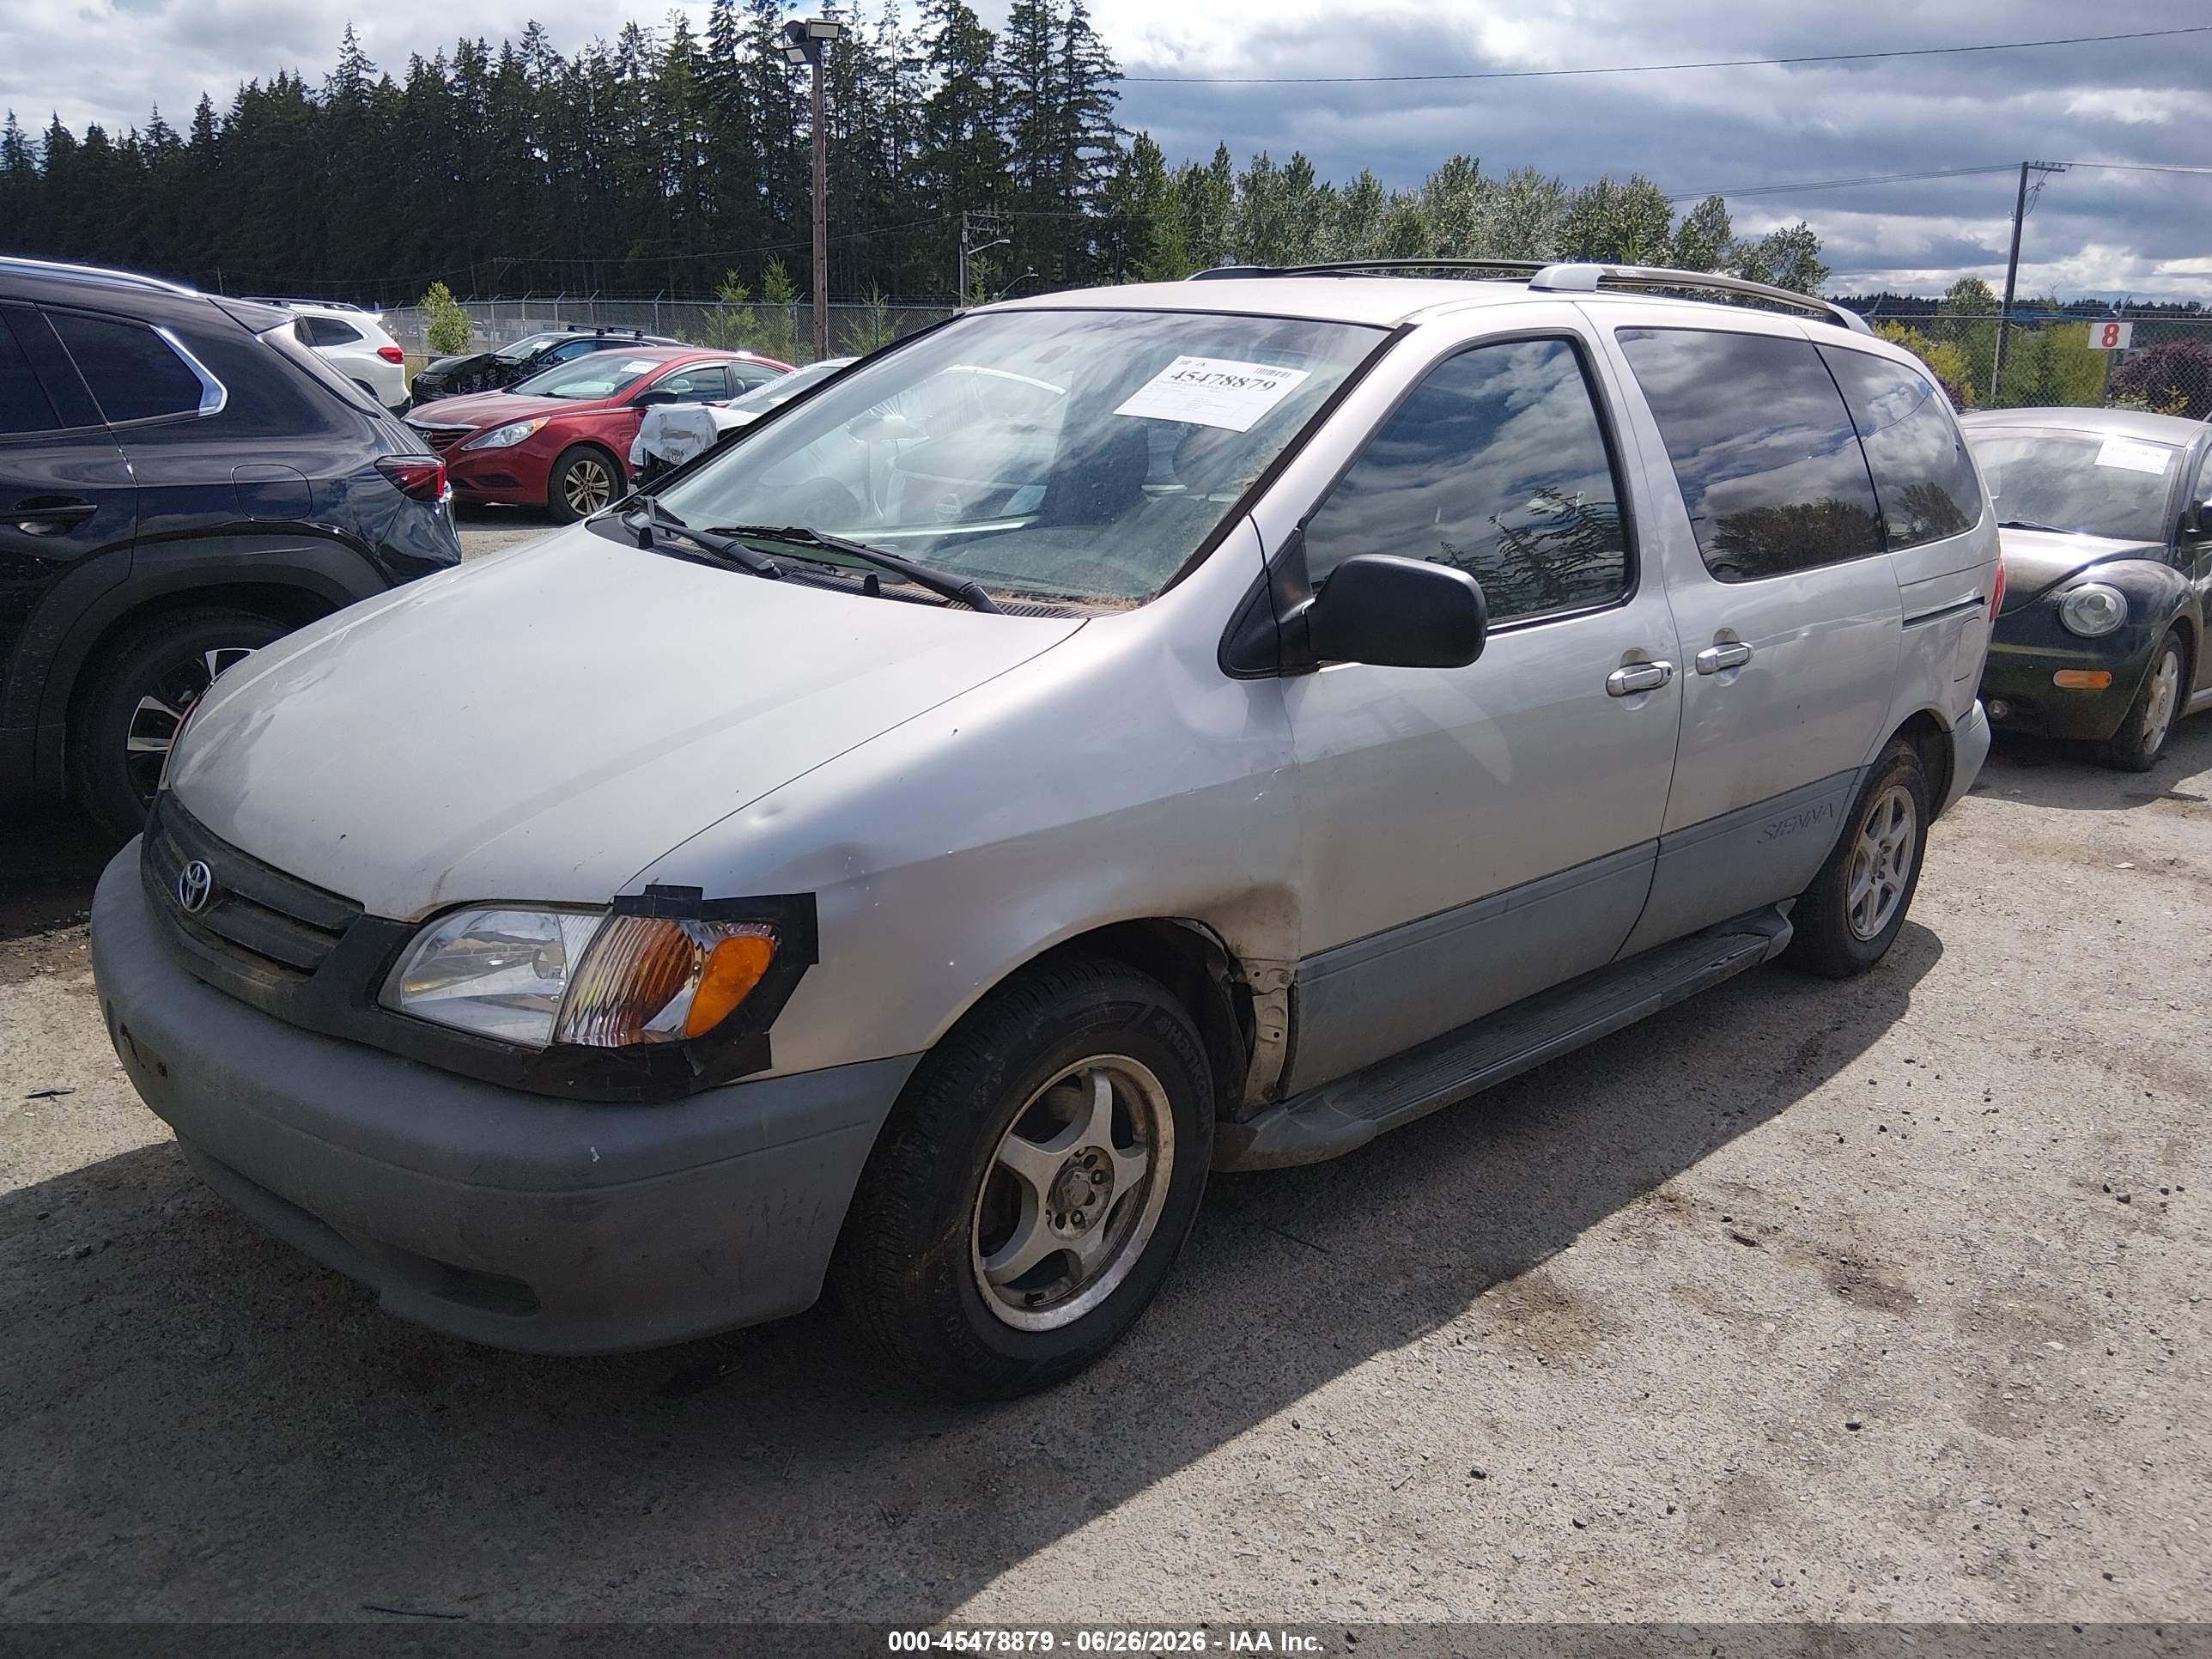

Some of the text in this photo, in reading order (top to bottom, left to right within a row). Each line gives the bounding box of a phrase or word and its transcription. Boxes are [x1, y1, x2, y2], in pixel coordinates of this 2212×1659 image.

[2101, 323, 2120, 348] 8
[1170, 370, 1277, 392] 45478879
[1756, 802, 1834, 845] SIENNA
